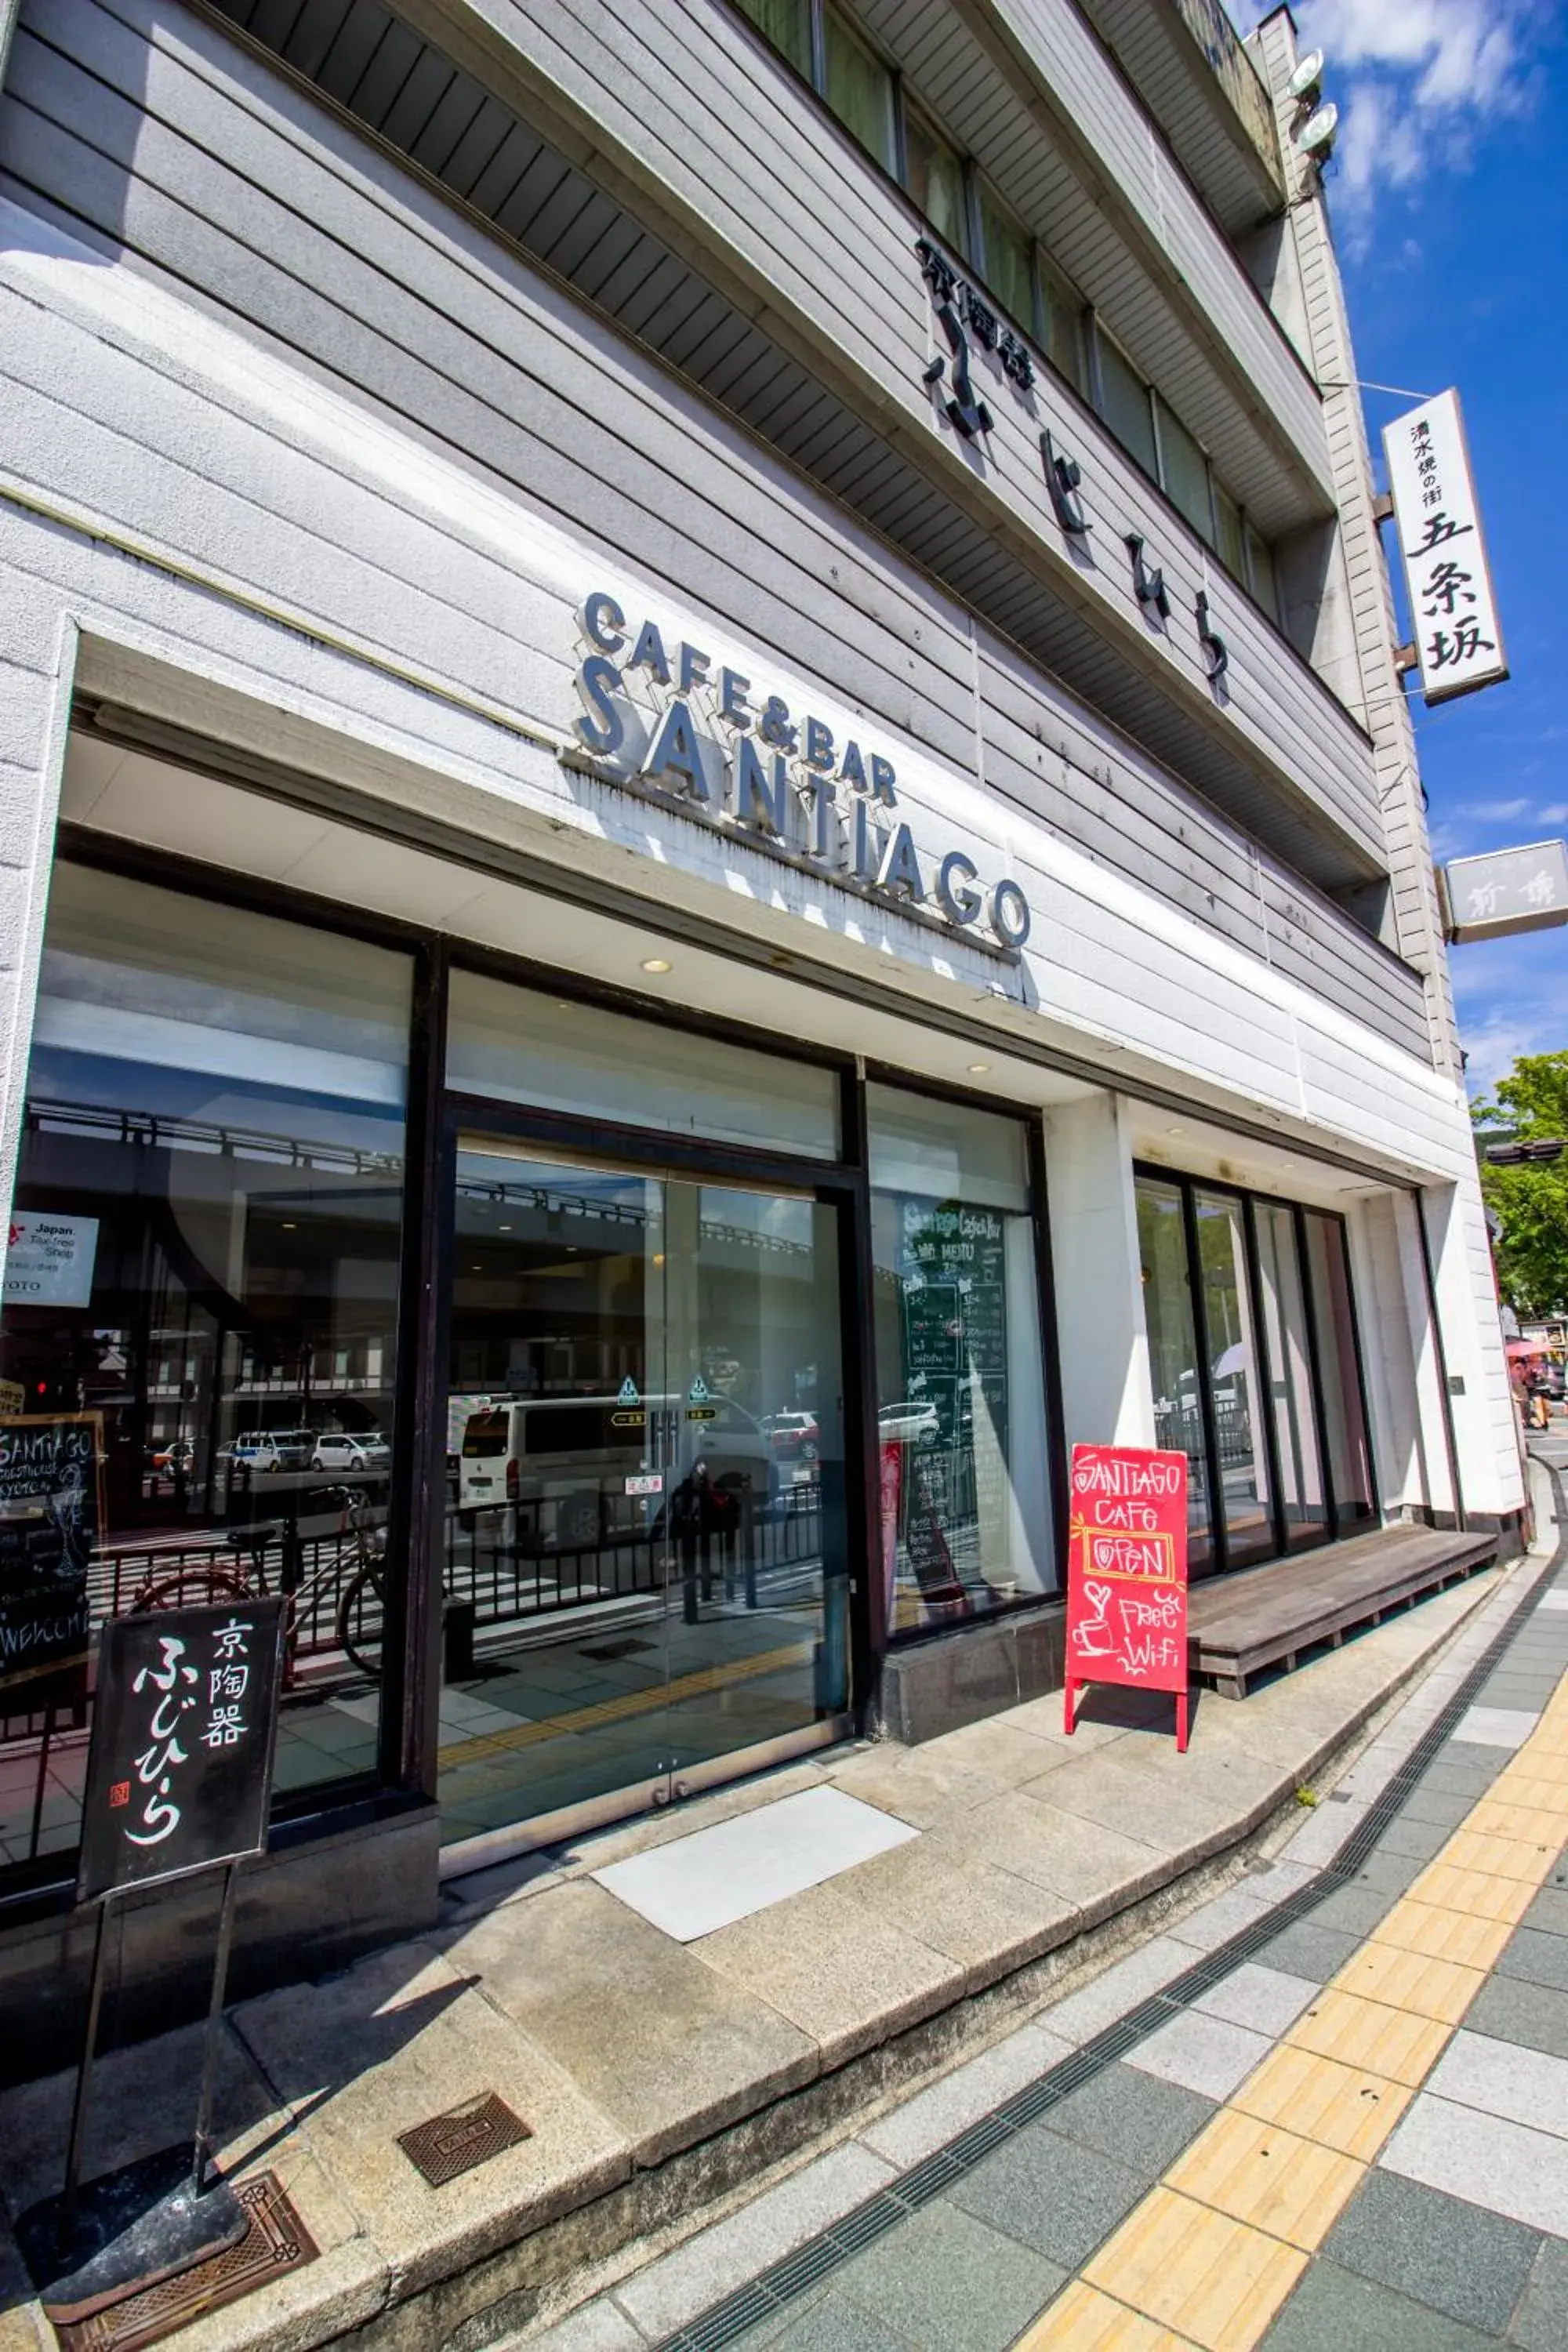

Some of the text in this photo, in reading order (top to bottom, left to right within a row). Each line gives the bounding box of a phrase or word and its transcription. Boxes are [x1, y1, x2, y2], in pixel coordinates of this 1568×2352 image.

[922, 306, 1229, 684] ふじひら
[1410, 419, 1443, 509] 清水焼の街
[1406, 511, 1496, 671] 五条坂
[572, 654, 1030, 949] SANTIAGO
[1074, 1454, 1181, 1497] SANTIAGO
[123, 1635, 199, 1846] ふじひら
[199, 1617, 254, 1748] 京陶器
